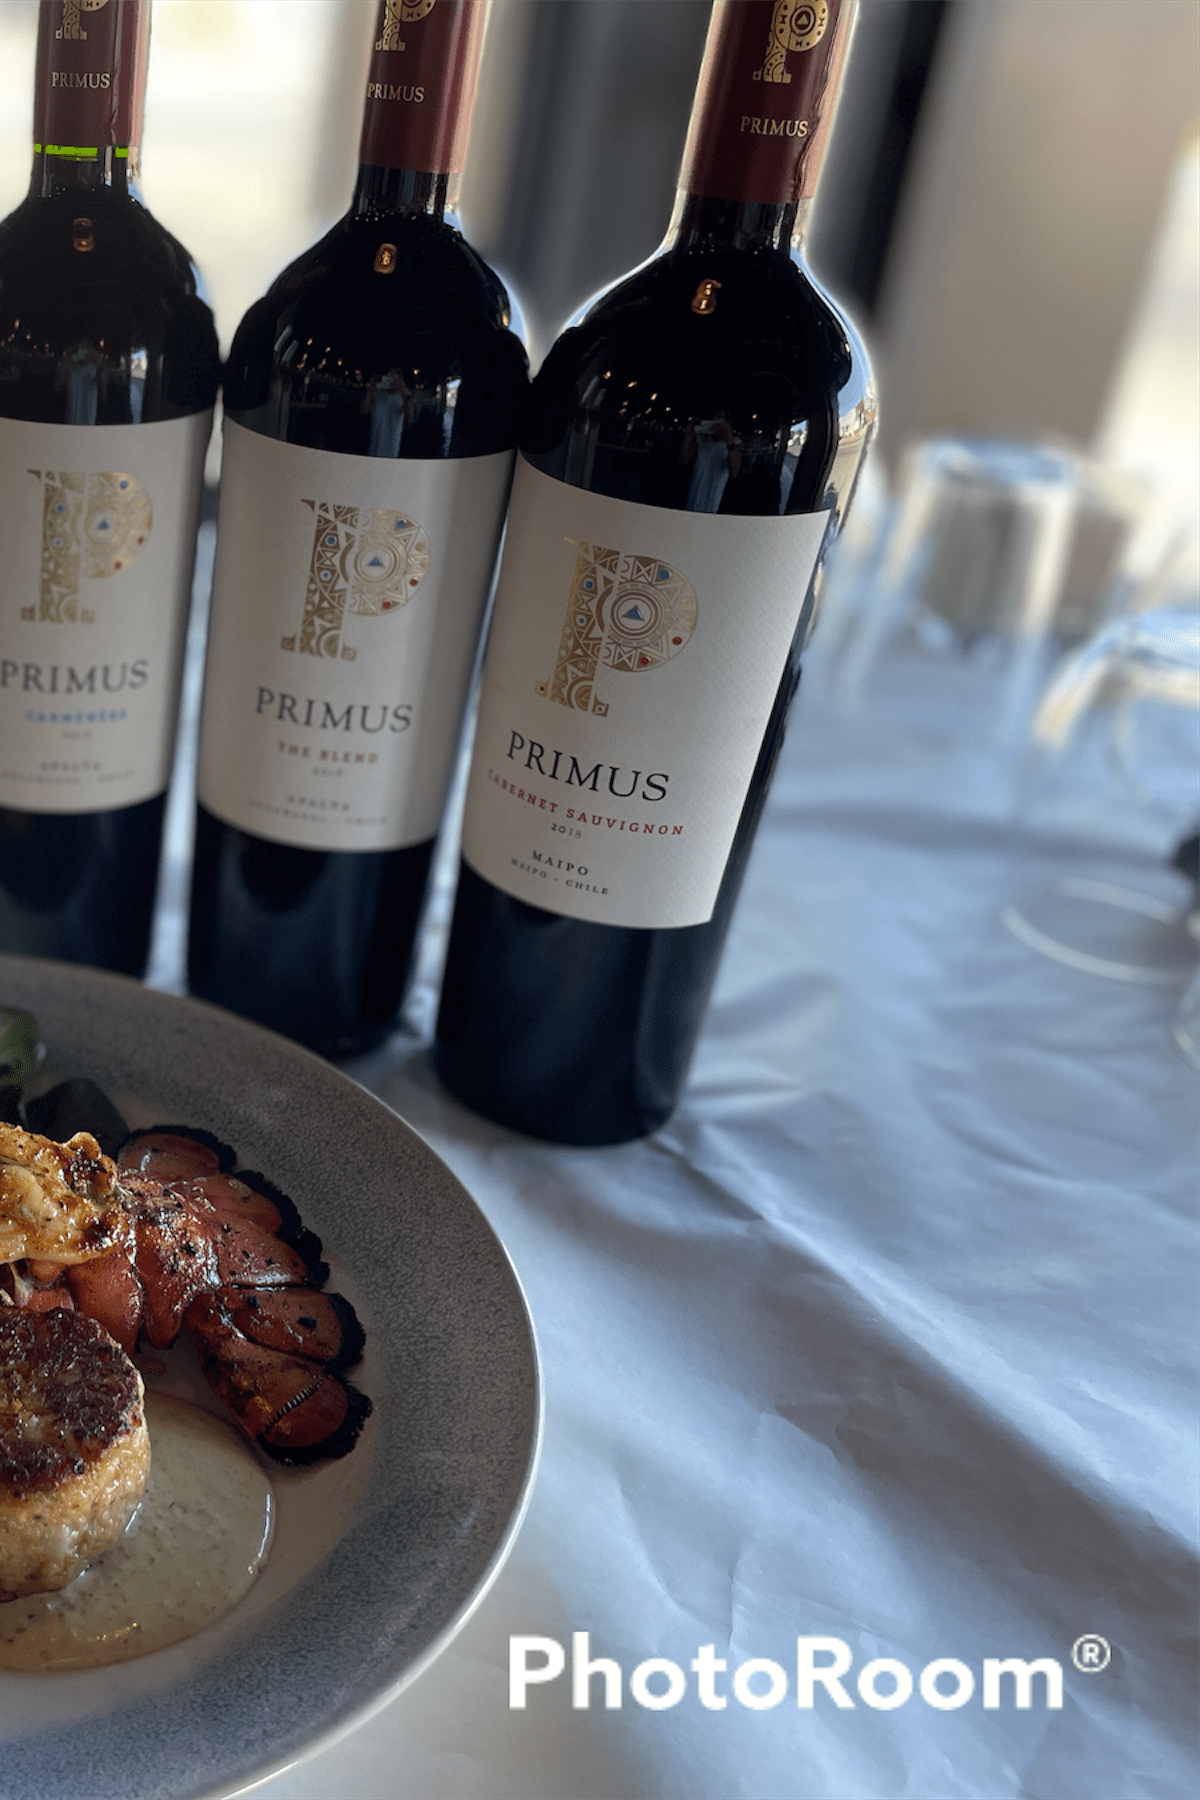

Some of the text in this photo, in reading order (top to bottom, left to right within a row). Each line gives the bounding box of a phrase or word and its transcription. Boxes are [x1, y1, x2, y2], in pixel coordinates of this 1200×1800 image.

[51, 71, 111, 89] PRIMUS
[367, 83, 425, 103] PRIMUS
[740, 116, 809, 137] PRIMUS
[0, 658, 149, 694] PRIMUS
[255, 686, 414, 734] PRIMUS
[277, 741, 379, 764] THE BLEND
[506, 730, 669, 802] PRIMUS
[487, 768, 684, 835] CABERNET SAUVIGNON
[551, 823, 582, 839] 2018
[511, 857, 547, 878] MAIPO
[565, 879, 609, 895] CHILE
[532, 851, 589, 876] MAIPO
